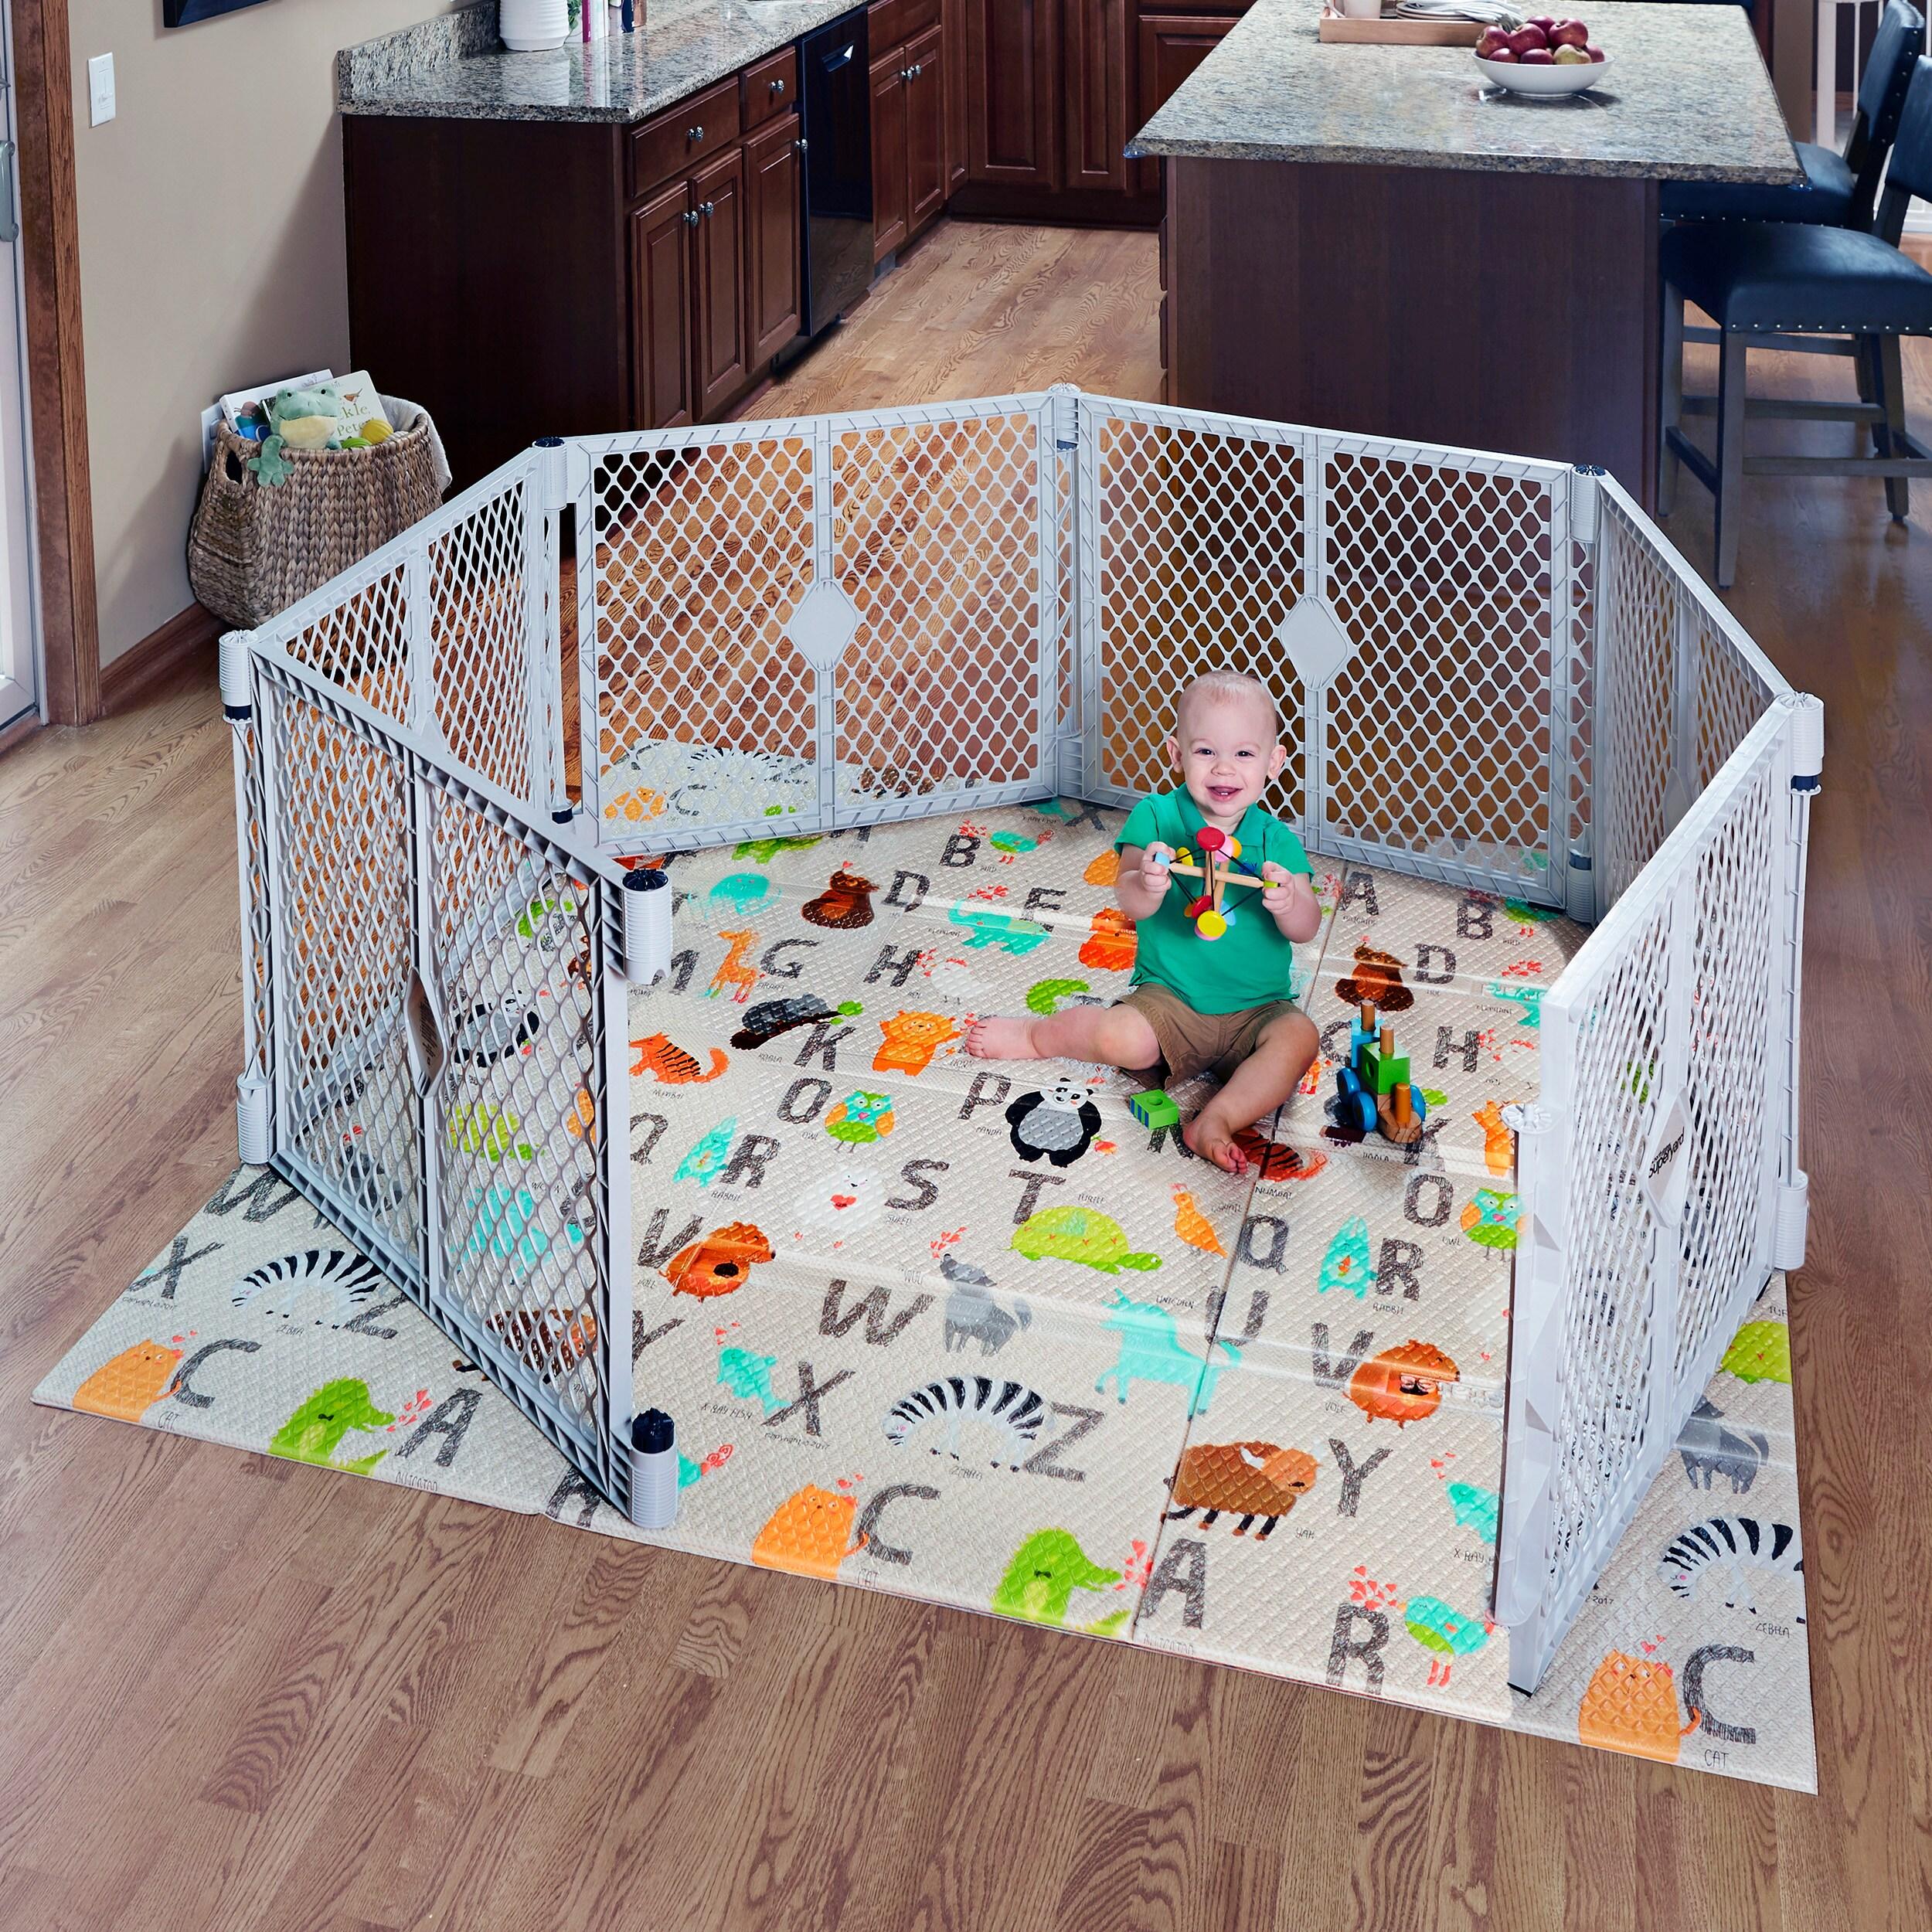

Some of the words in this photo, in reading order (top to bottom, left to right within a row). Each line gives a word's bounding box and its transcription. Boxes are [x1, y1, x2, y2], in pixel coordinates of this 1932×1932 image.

[939, 834, 981, 867] B
[881, 870, 930, 913] D
[1019, 888, 1067, 932] E
[1340, 871, 1379, 916] A
[1457, 898, 1495, 940] B
[760, 938, 821, 979] G
[863, 945, 923, 987] H
[1413, 943, 1457, 985] D
[794, 1024, 856, 1072] K
[1432, 1026, 1481, 1073] H
[777, 1078, 832, 1124] O
[957, 1071, 1012, 1120] P
[719, 1134, 781, 1189] R
[884, 1158, 950, 1212] S
[1009, 1168, 1066, 1225] T
[1403, 1174, 1454, 1228] O
[637, 1209, 704, 1268] V
[1238, 1214, 1289, 1275] Q
[128, 1236, 224, 1299] X
[1376, 1237, 1423, 1301] R
[818, 1278, 935, 1347] W
[170, 1338, 262, 1408] C
[760, 1361, 856, 1437] X
[394, 1388, 483, 1467] A
[1023, 1401, 1106, 1482] Z
[1328, 1438, 1393, 1517] Y
[857, 1484, 941, 1565] C
[1140, 1538, 1206, 1629] A
[1682, 1644, 1757, 1744] C
[1704, 1749, 1730, 1767] CAT
